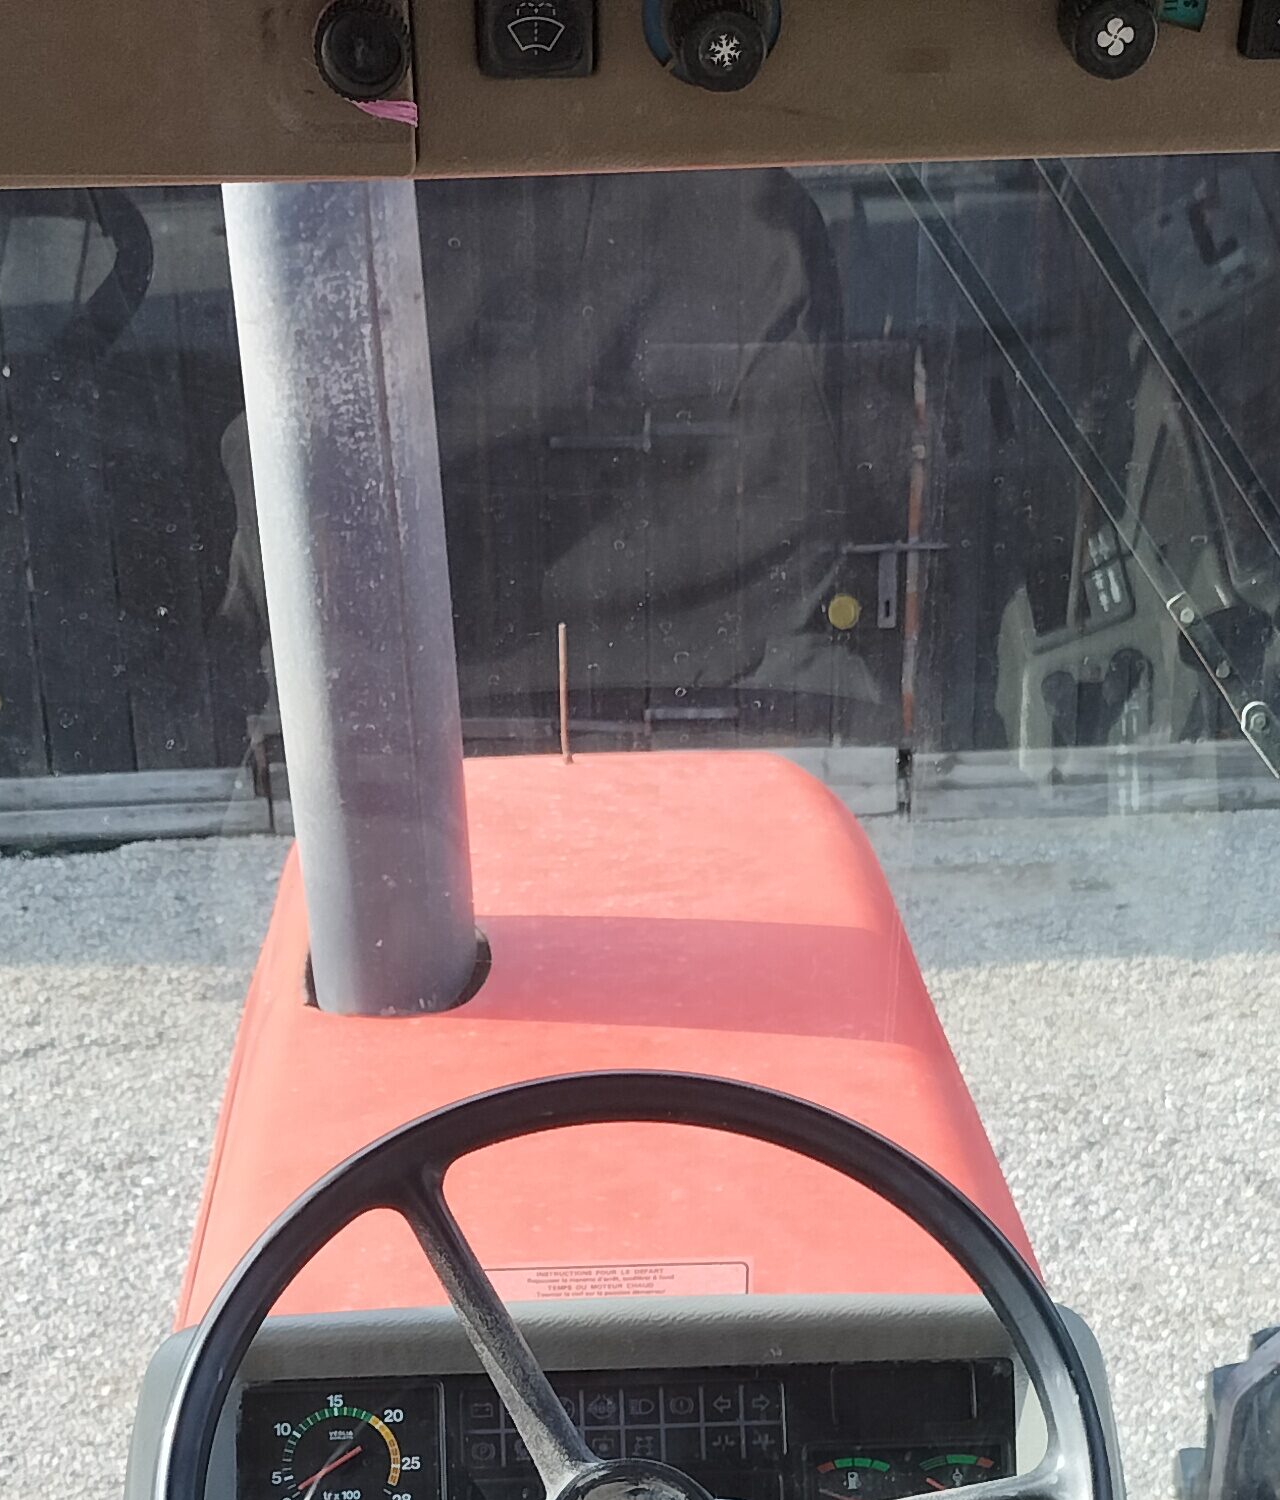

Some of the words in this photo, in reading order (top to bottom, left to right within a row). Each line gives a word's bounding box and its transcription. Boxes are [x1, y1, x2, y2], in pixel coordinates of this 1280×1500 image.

[326, 1394, 344, 1408] 15
[383, 1409, 404, 1423] 20
[273, 1422, 292, 1436] 10
[401, 1456, 421, 1470] 25
[271, 1471, 282, 1485] 5
[322, 1491, 334, 1500] tr
[342, 1490, 361, 1500] 100
